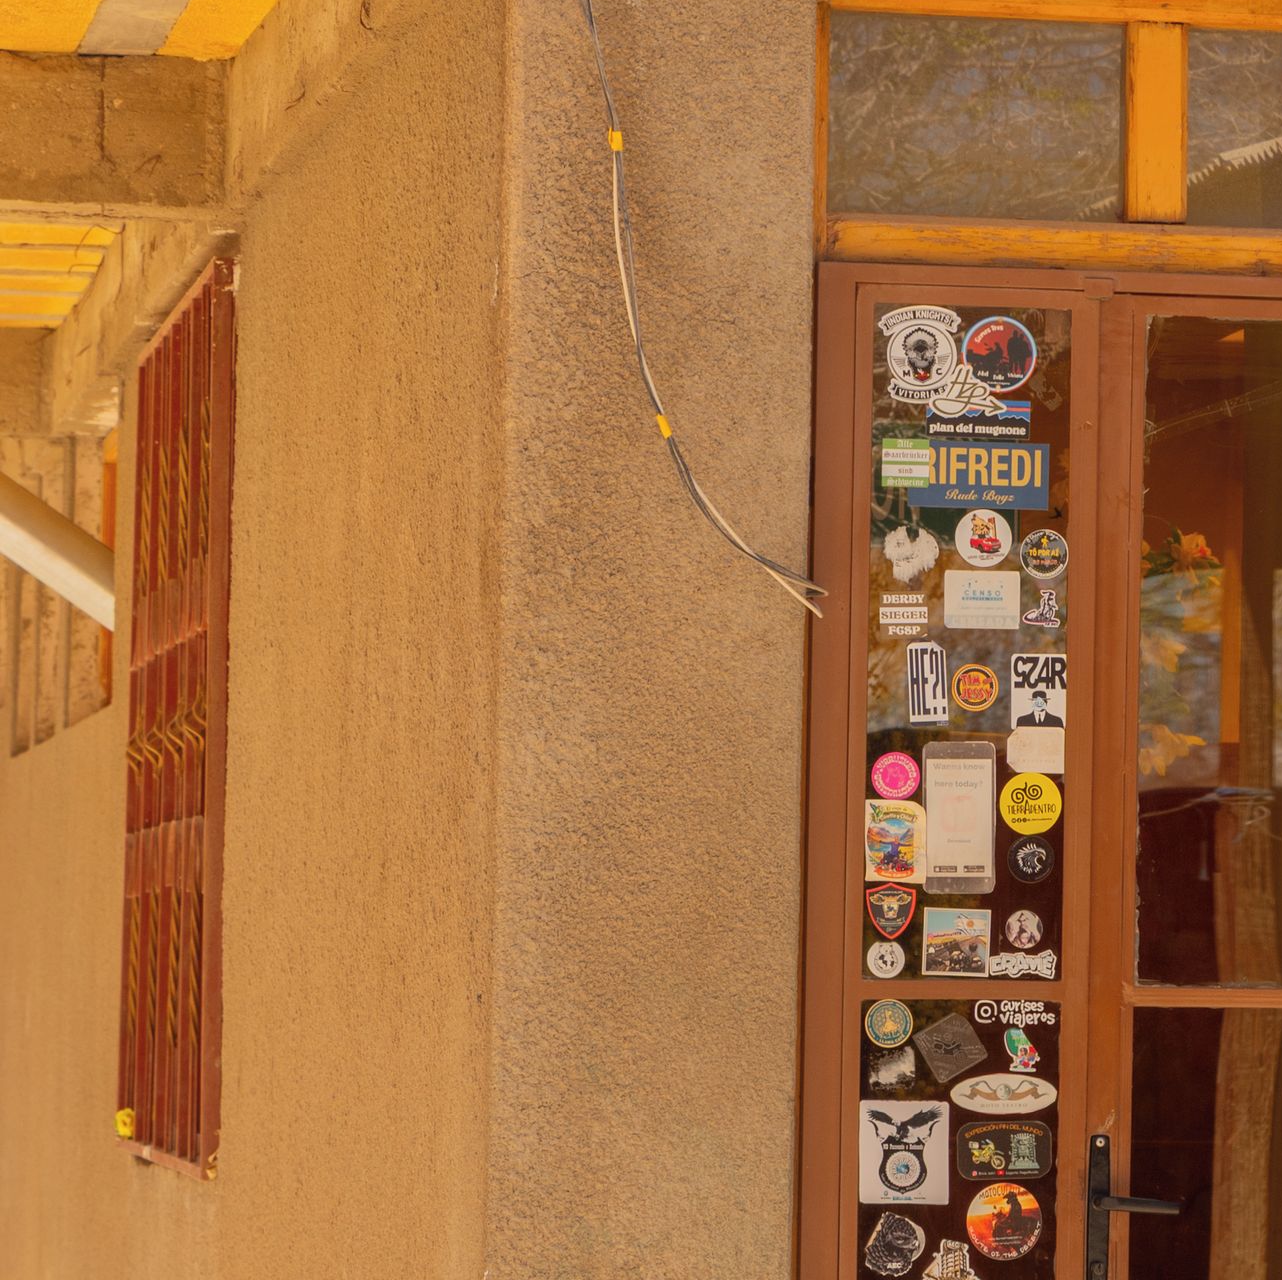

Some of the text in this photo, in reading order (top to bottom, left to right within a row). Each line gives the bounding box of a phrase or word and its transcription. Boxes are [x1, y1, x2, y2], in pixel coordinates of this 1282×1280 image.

[886, 310, 951, 327] INDIAN KNIGHTS
[935, 368, 943, 376] C
[898, 385, 946, 399] VITORIA.E
[955, 423, 973, 433] del
[975, 425, 1027, 436] mugnone
[945, 488, 978, 501] Rude
[883, 594, 924, 604] DERBY
[881, 610, 927, 619] SIEGER
